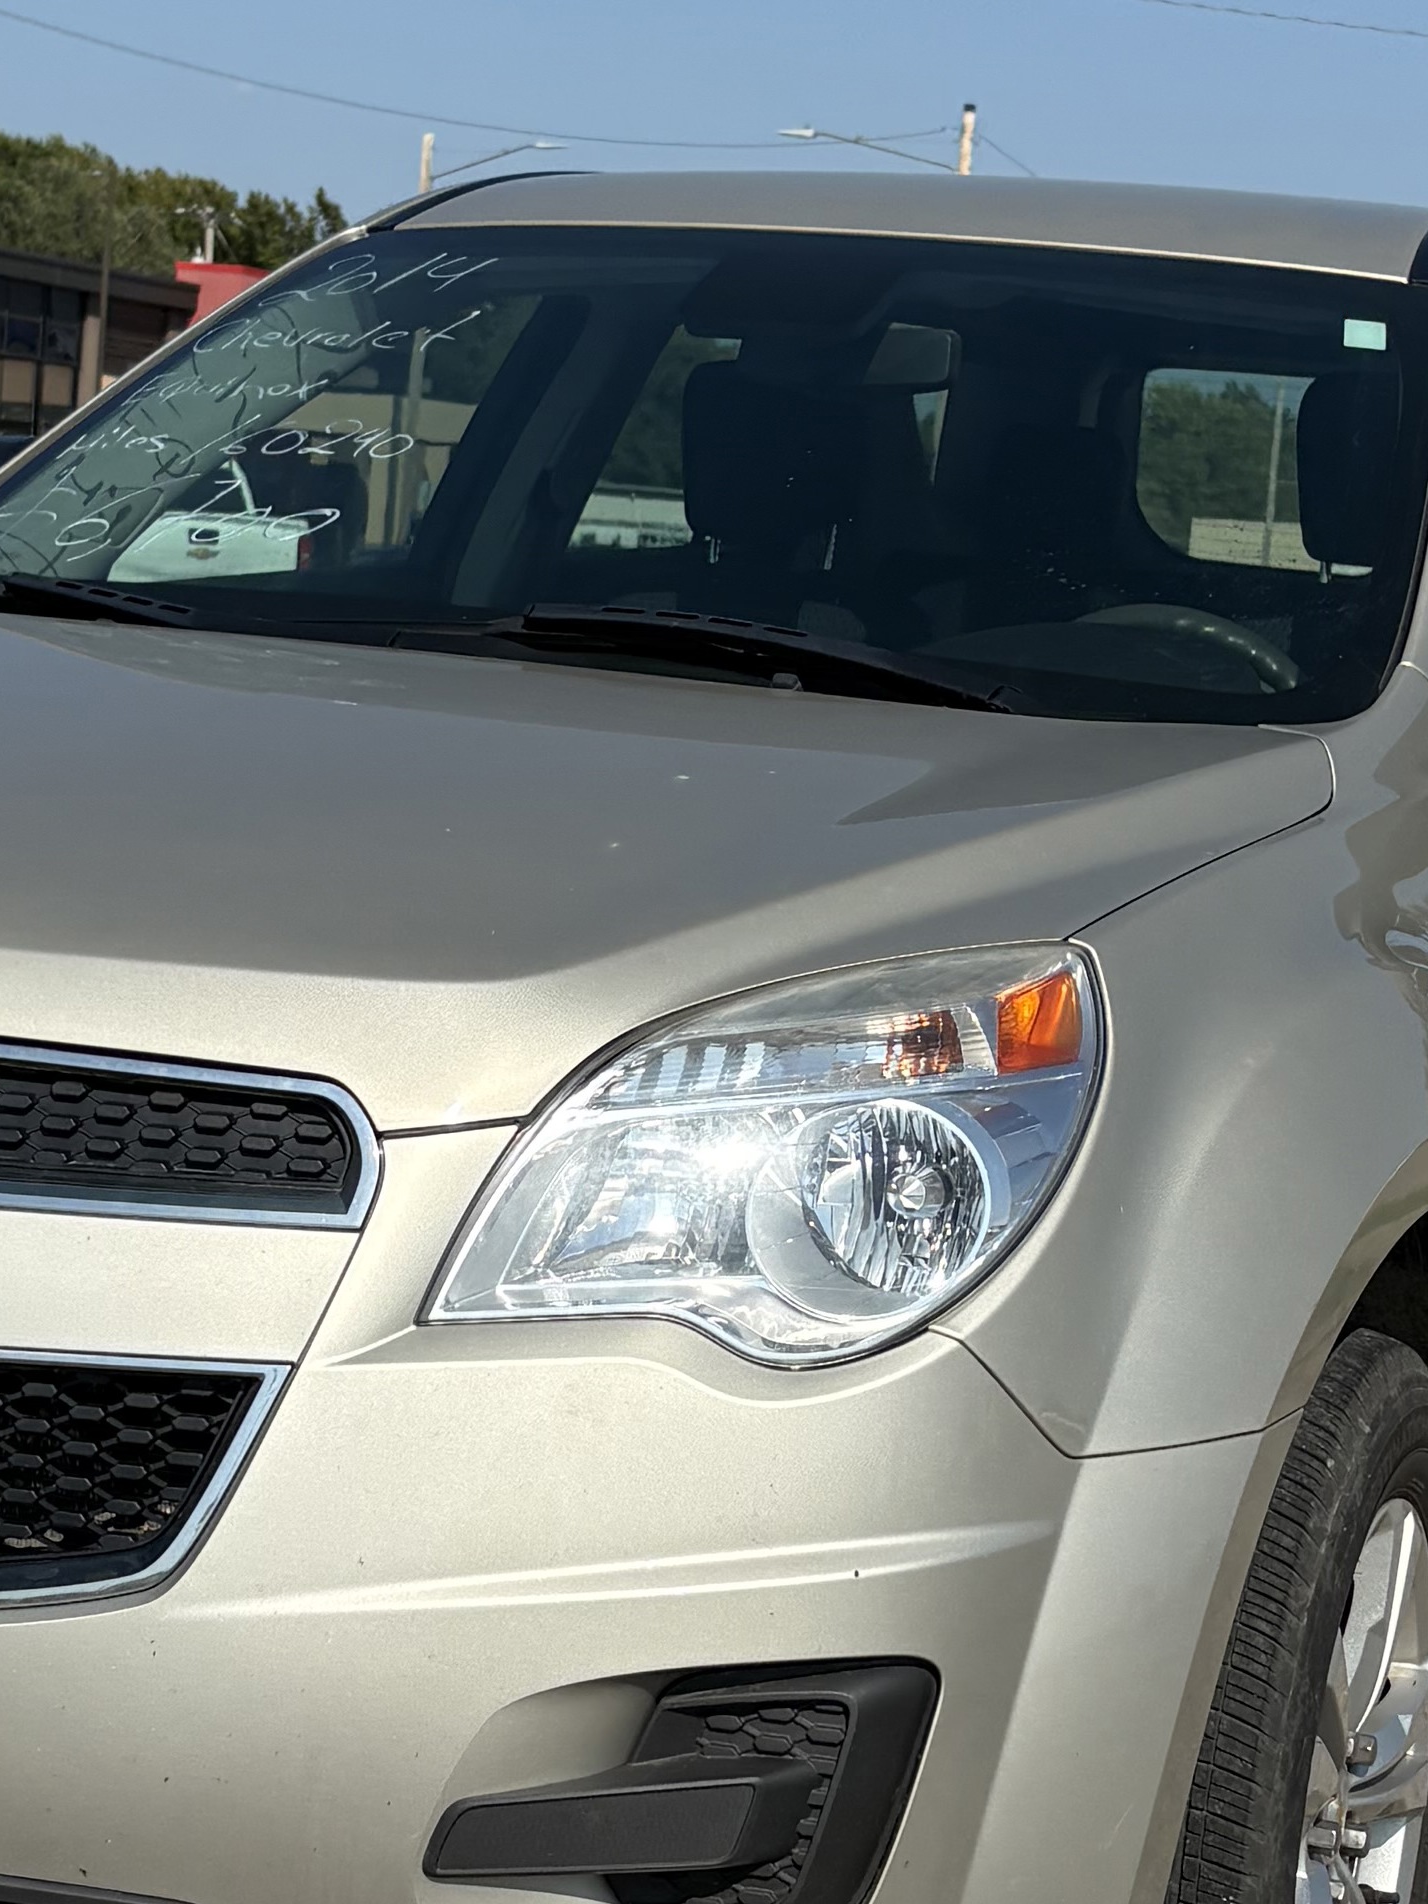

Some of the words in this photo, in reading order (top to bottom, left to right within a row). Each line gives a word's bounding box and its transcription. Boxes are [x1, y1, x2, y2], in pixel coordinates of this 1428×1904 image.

[258, 252, 499, 307] 2014
[193, 310, 481, 353] Chevrolet
[121, 372, 329, 405] Equinox
